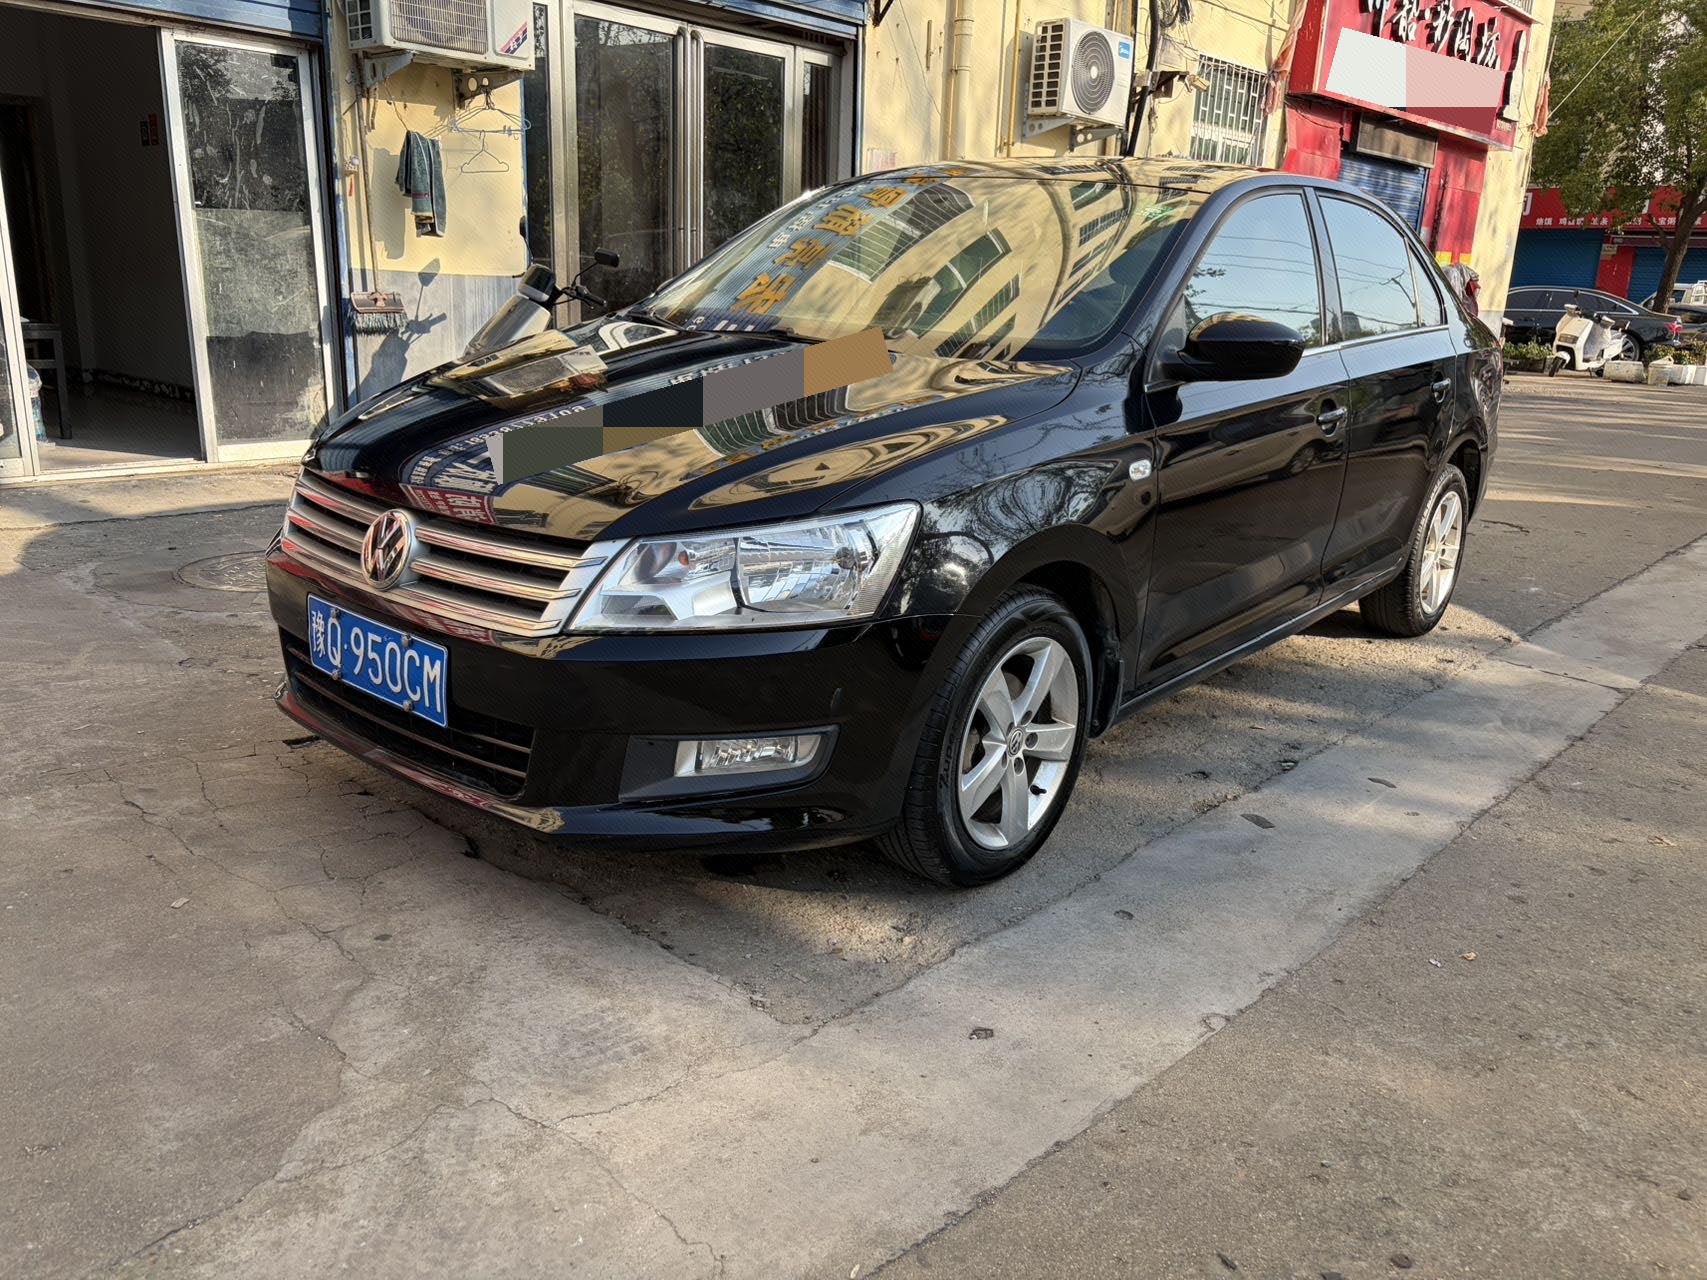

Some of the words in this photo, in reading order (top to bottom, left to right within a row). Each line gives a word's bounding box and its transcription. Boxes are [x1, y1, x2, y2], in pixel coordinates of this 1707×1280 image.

[1366, 0, 1501, 70] 韶·彩陶坊
[310, 609, 442, 714] 豫Q·950CM
